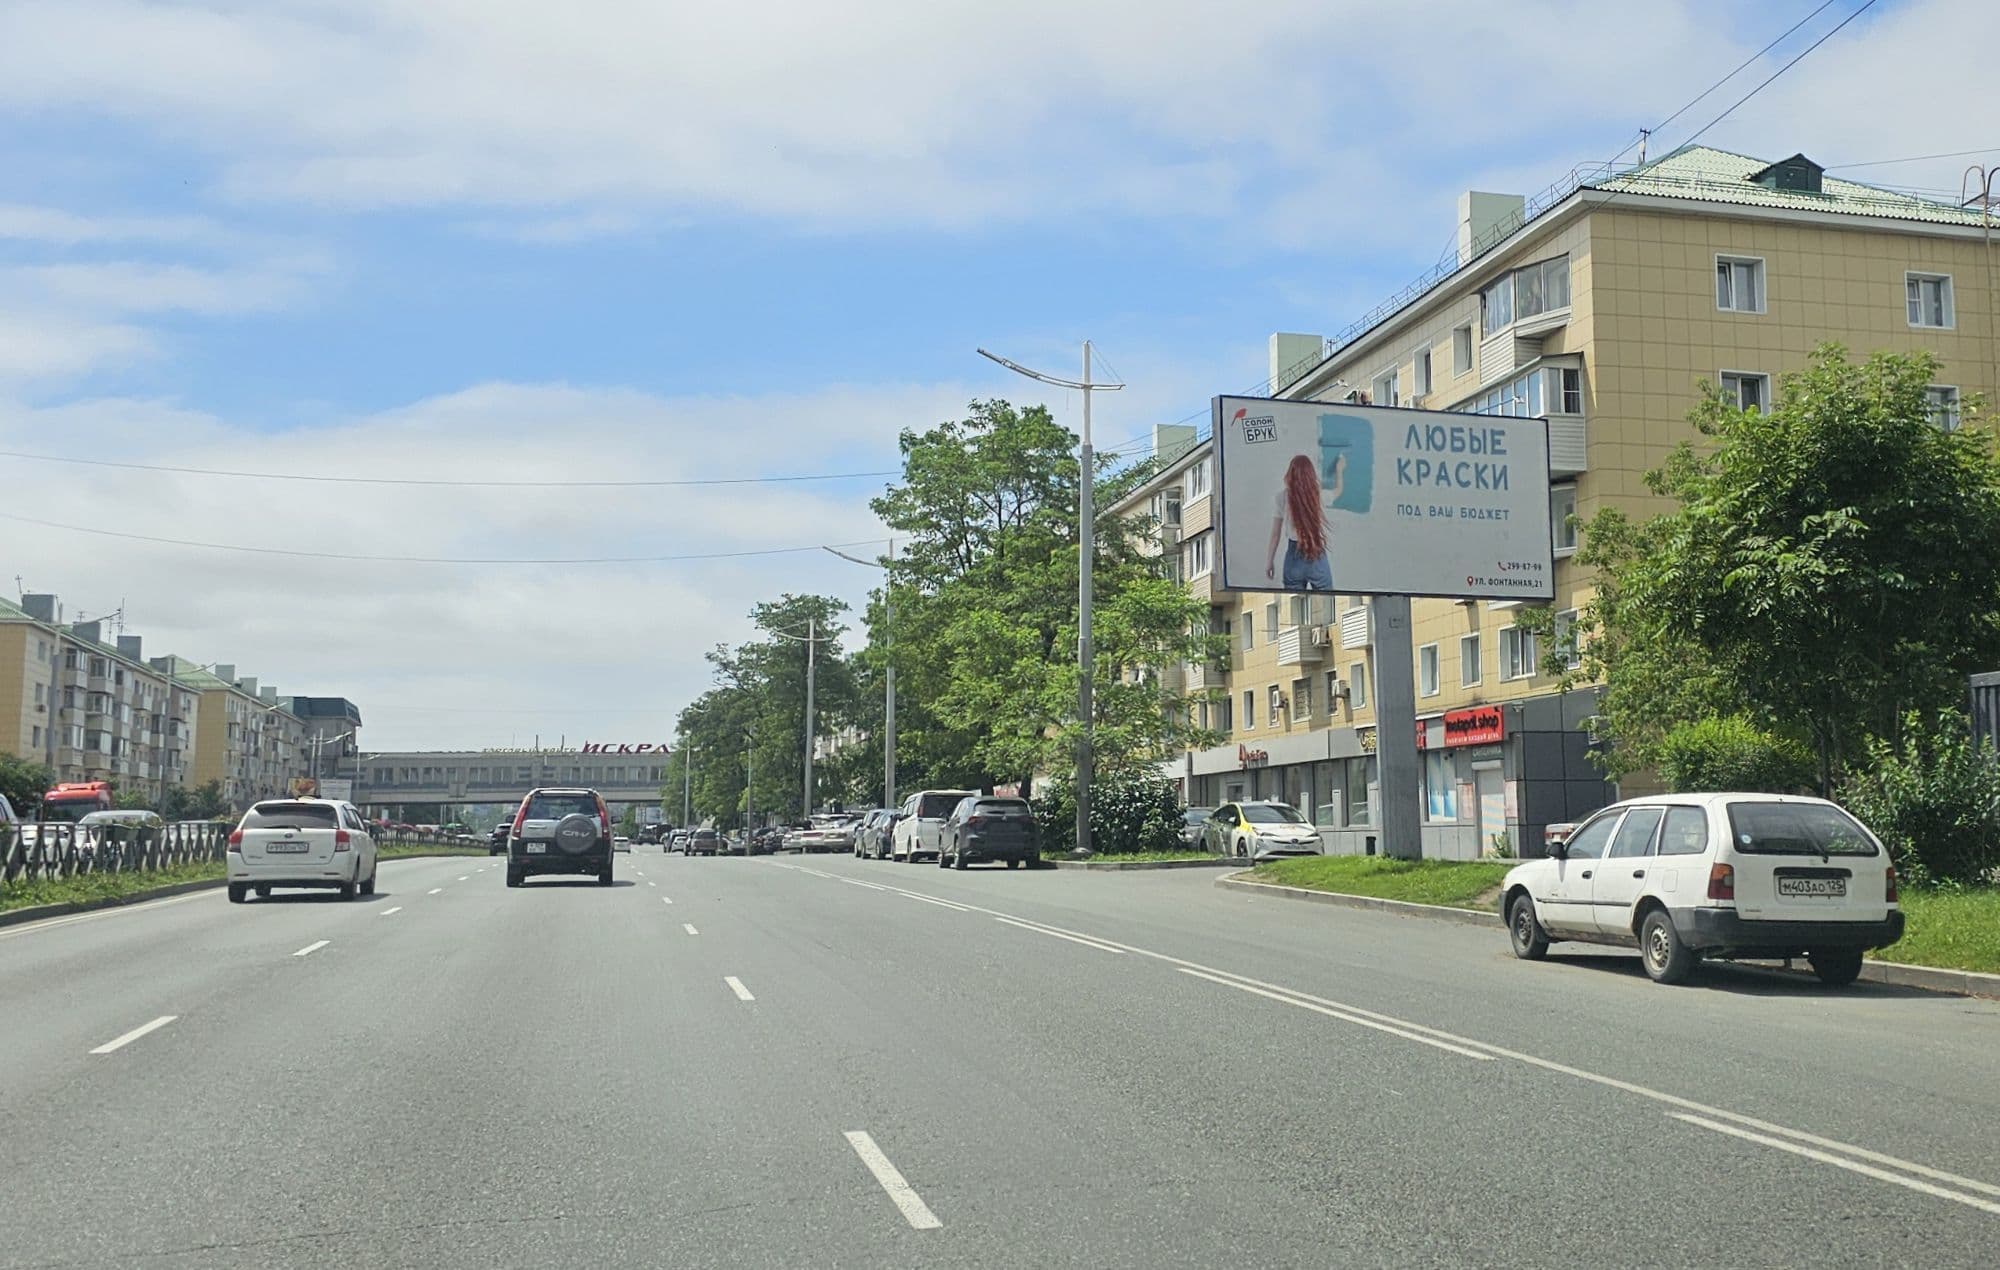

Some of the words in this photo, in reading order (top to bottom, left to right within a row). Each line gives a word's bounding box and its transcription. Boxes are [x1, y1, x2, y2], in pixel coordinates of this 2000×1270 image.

[1246, 427, 1275, 442] БРУК
[1405, 424, 1507, 455] ЛЮБЫЕ
[1397, 457, 1509, 491] КРАСКИ
[1397, 504, 1421, 516] ПОД
[1429, 506, 1453, 517] ВАШ
[1460, 507, 1510, 520] БЮДЖЕТ
[1783, 881, 1826, 892] М403АО
[1827, 880, 1842, 890] 125
